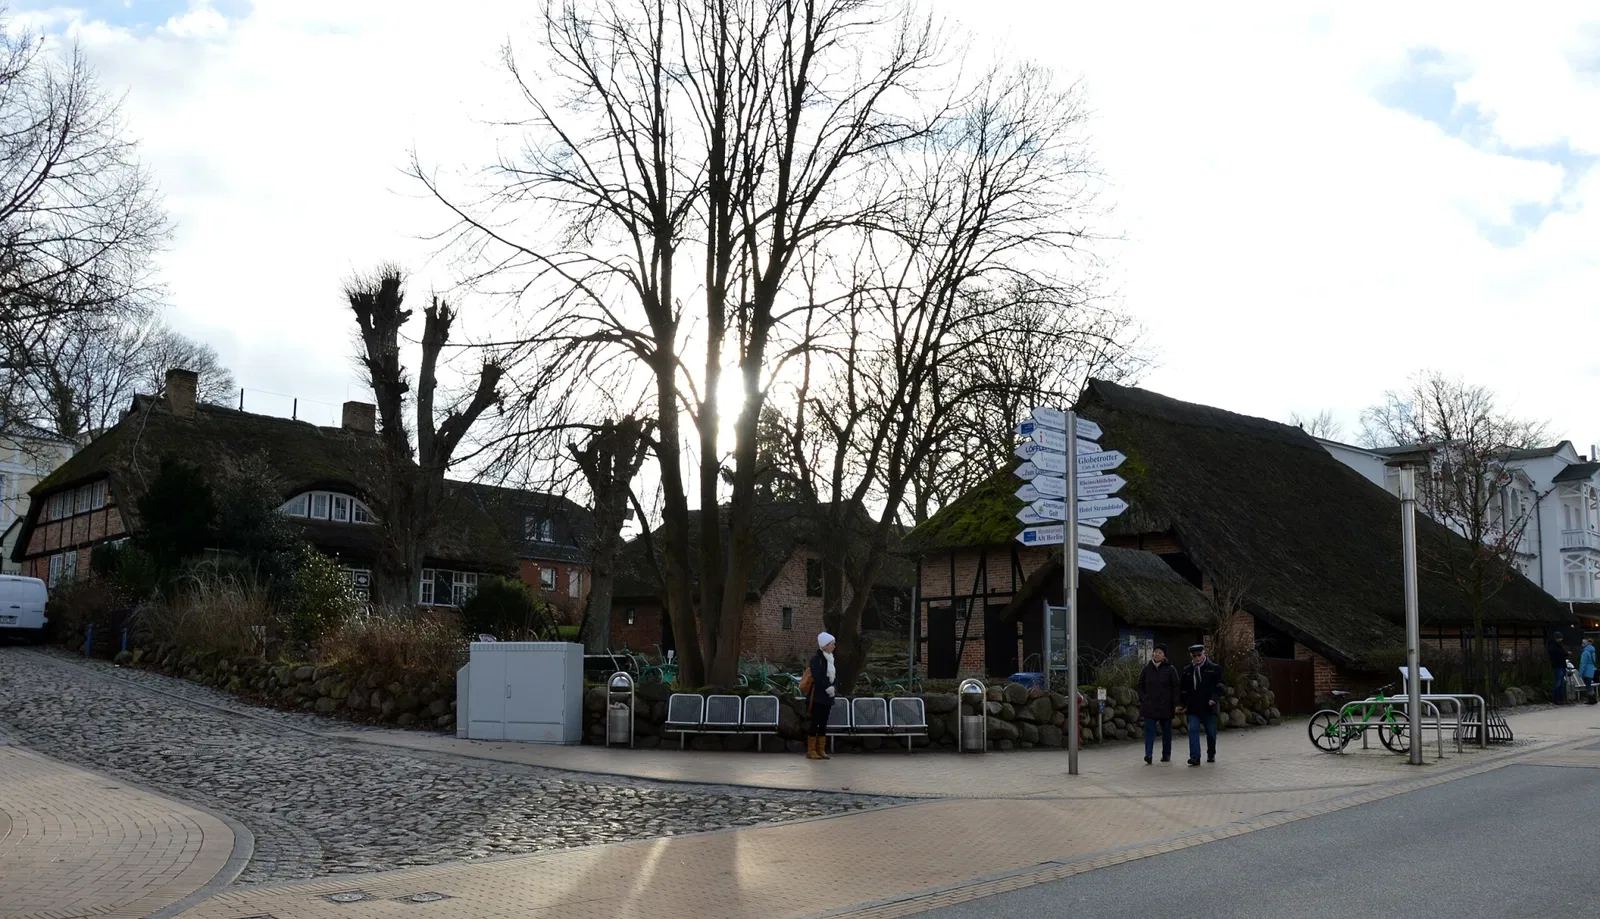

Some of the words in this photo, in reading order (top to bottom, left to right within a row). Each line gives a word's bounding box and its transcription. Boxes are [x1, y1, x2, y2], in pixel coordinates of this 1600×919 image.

[1078, 454, 1118, 465] Globetrotter
[1043, 501, 1065, 510] Abenteuer
[1046, 532, 1064, 541] Berlin
